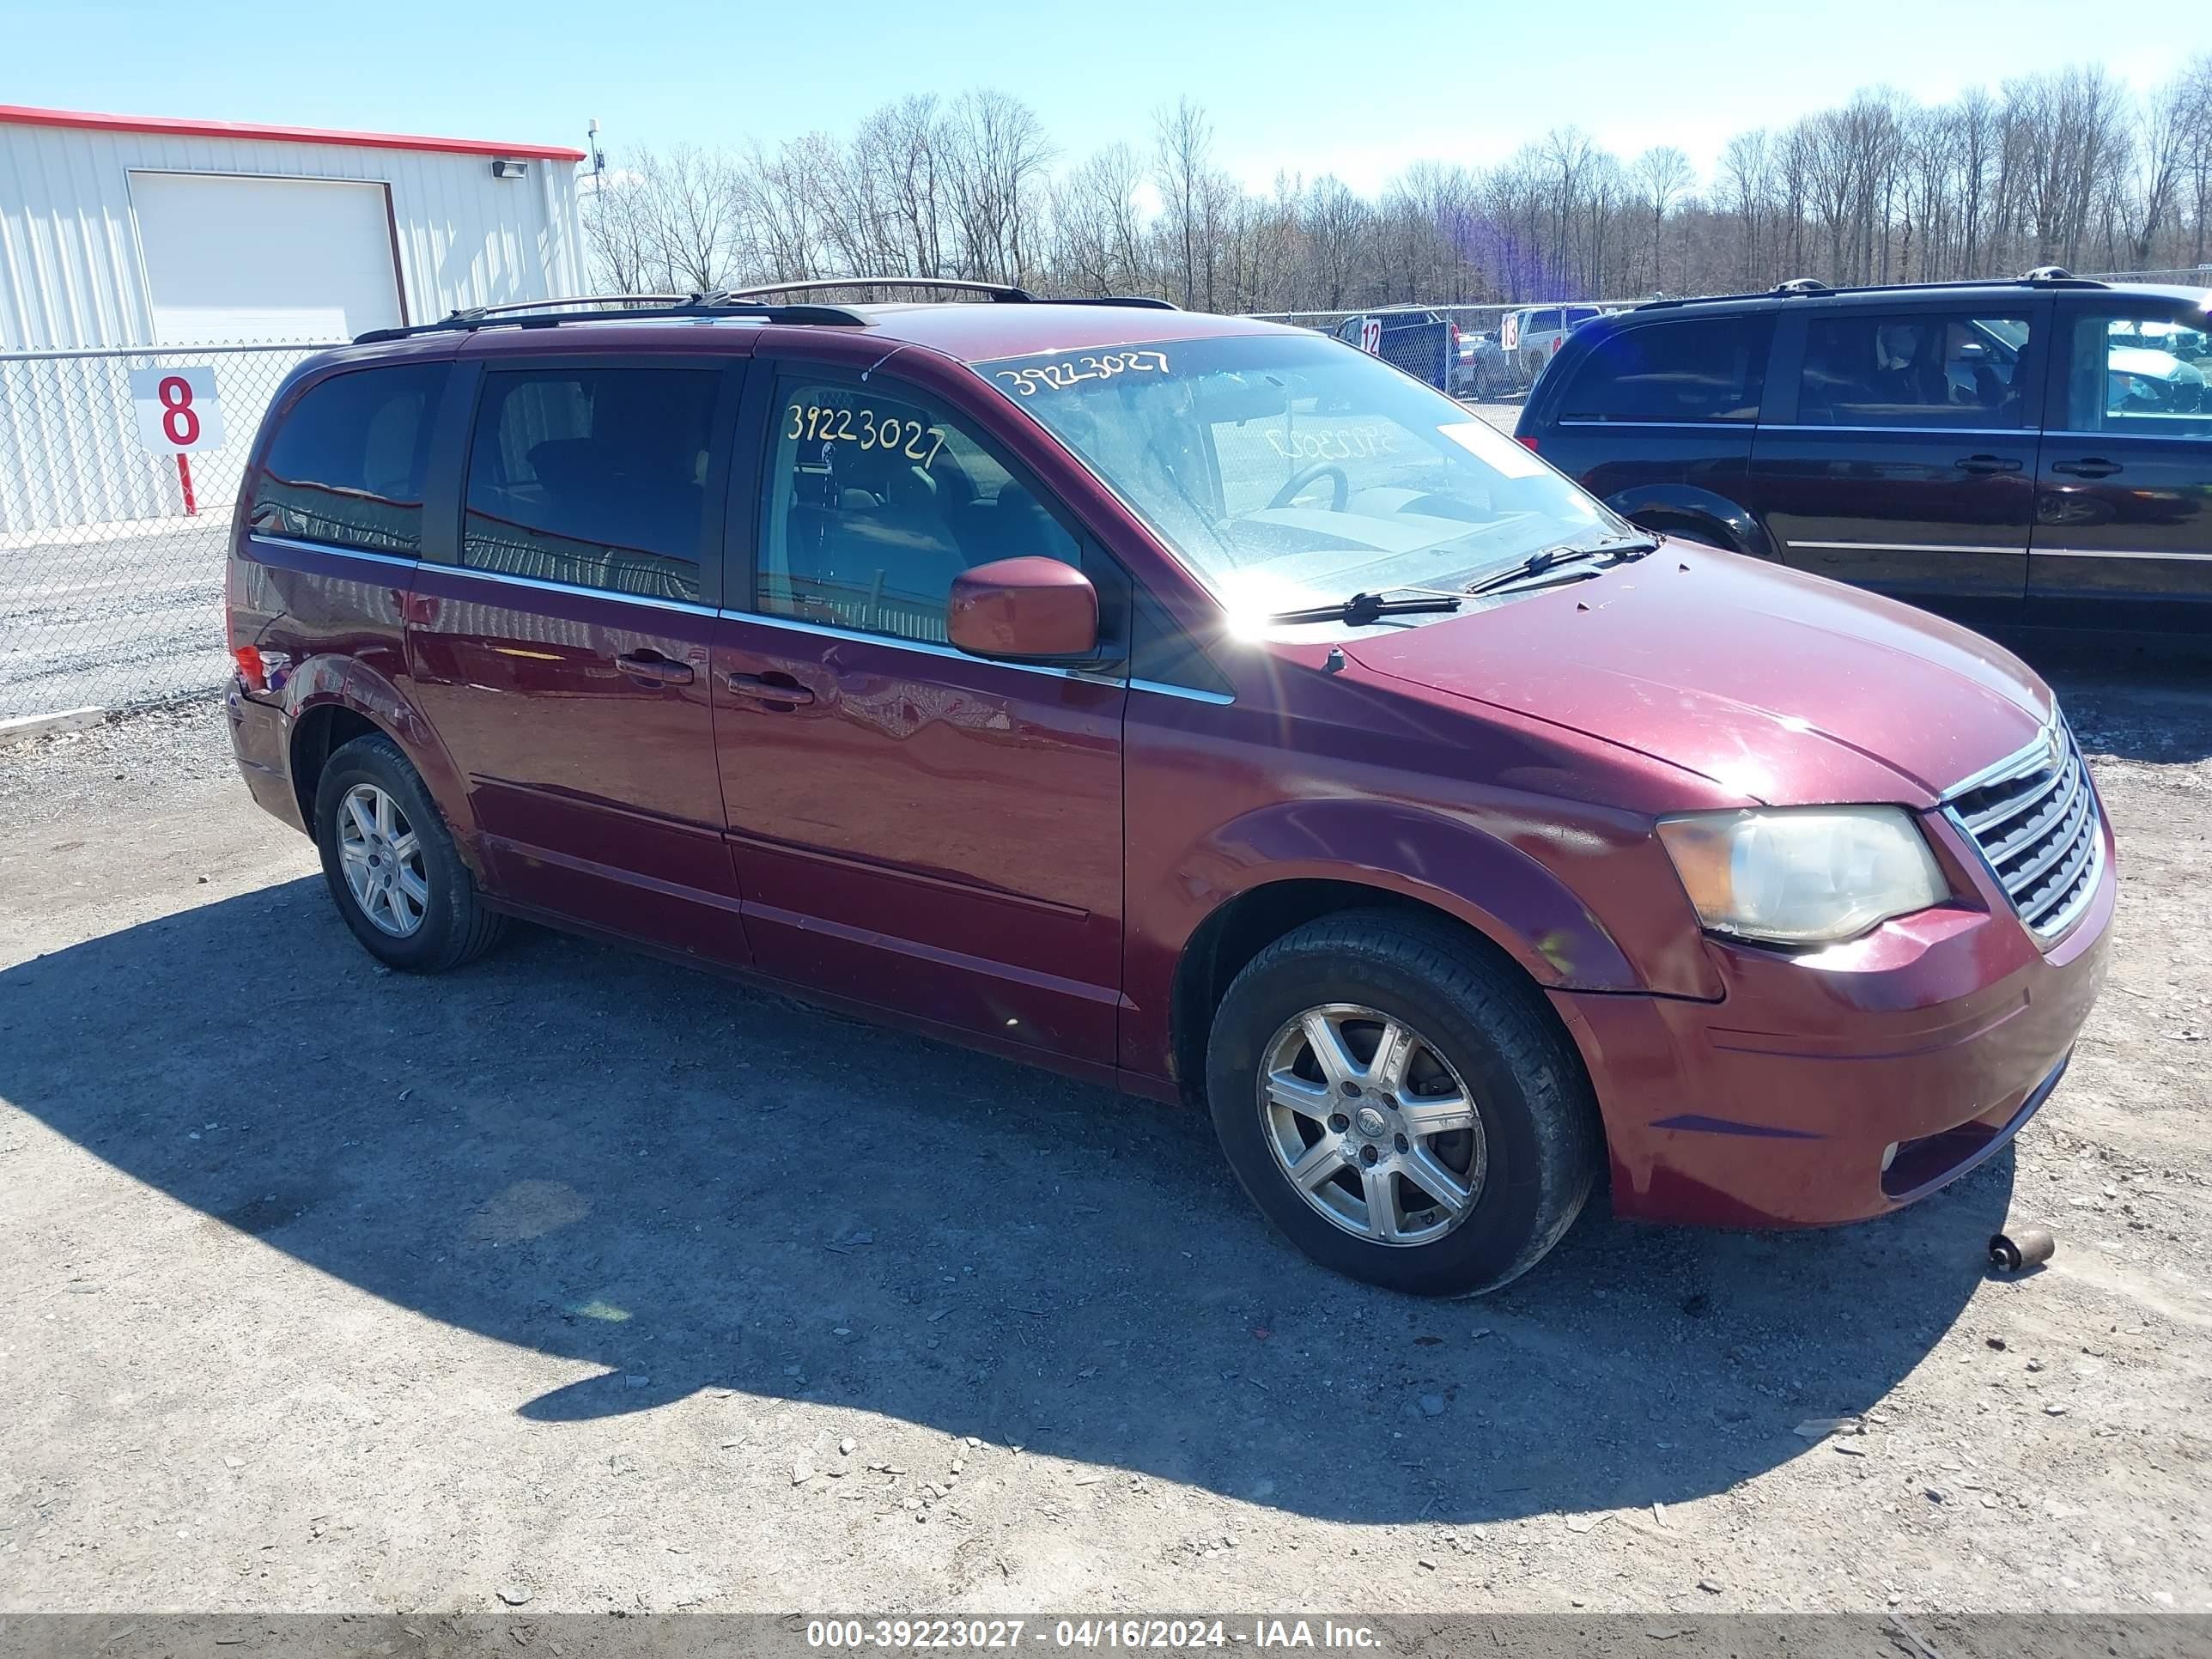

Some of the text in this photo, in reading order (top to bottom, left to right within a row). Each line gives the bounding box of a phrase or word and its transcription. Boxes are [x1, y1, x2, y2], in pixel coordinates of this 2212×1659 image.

[1363, 323, 1379, 356] 12
[1503, 316, 1516, 346] 13
[995, 350, 1170, 397] 39223027
[158, 375, 200, 446] 8
[787, 404, 945, 470] 39223027
